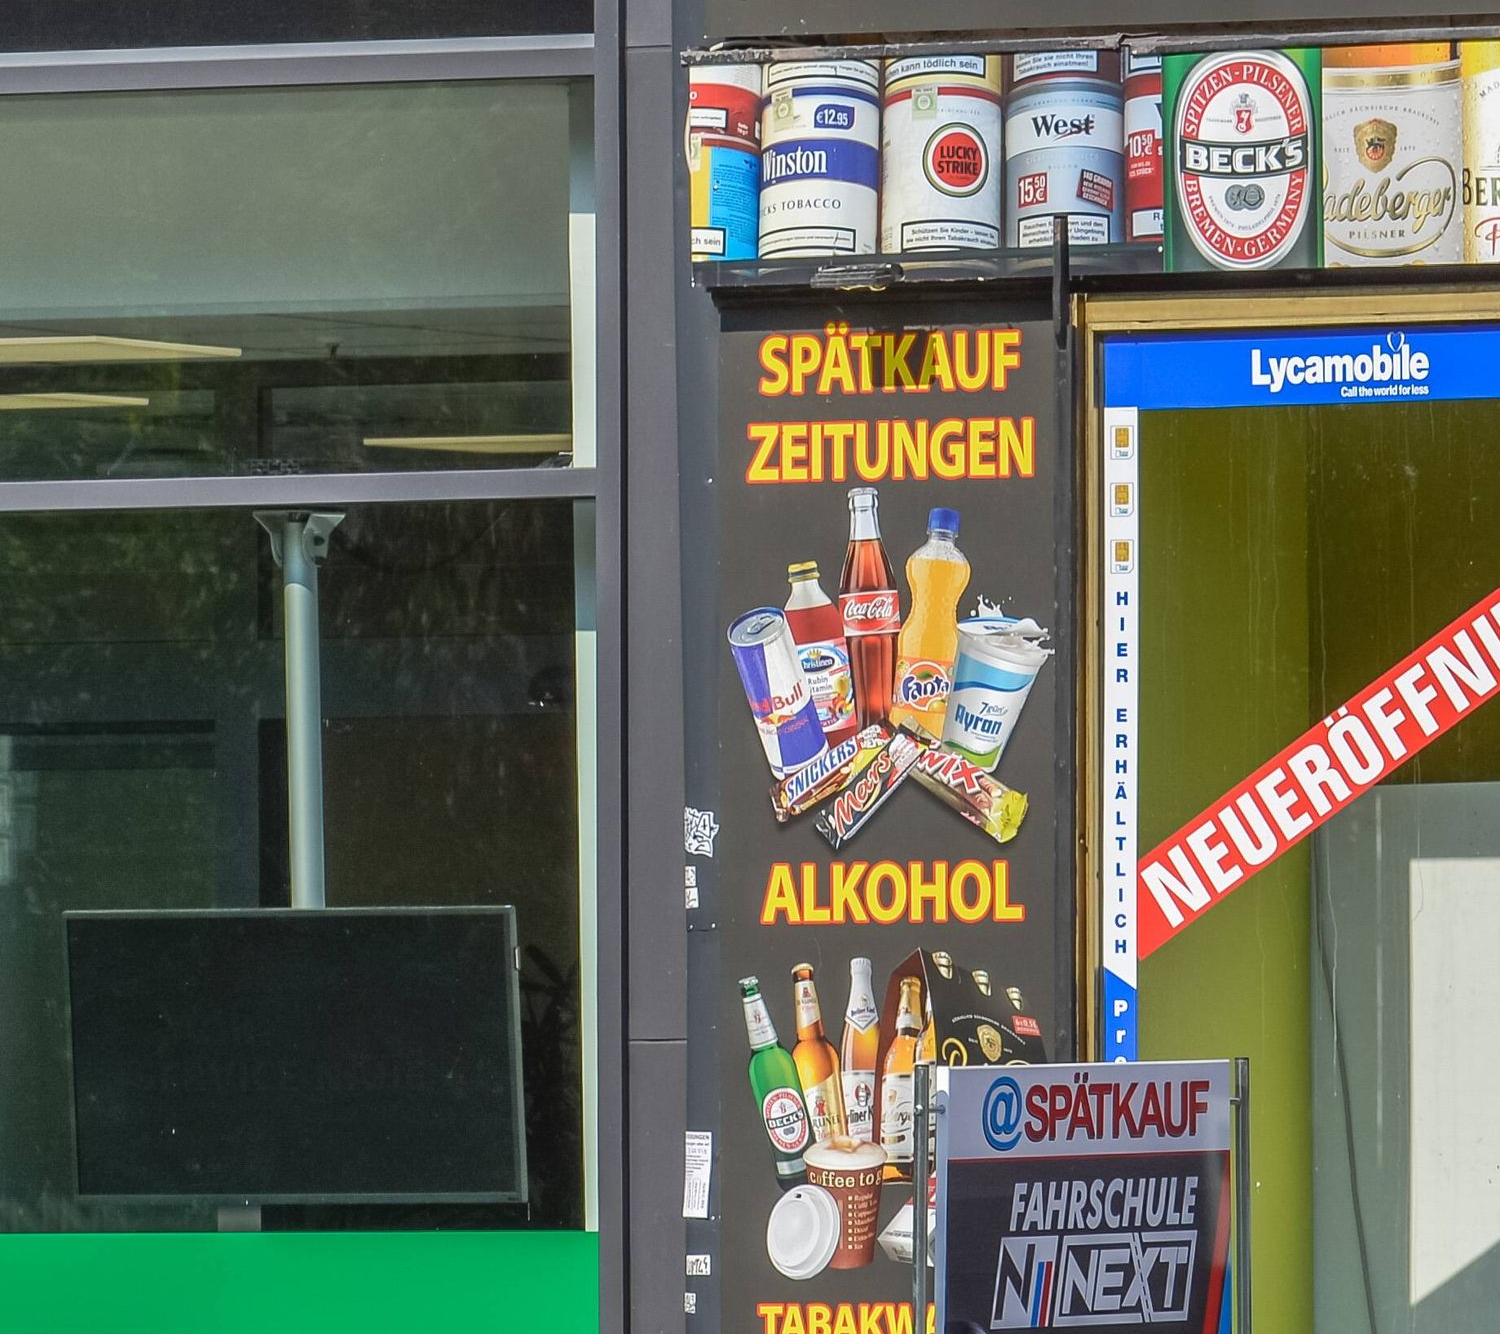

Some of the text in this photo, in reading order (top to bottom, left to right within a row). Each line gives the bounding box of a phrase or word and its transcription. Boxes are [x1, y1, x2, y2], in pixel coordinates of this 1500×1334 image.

[900, 59, 979, 72] kann tödlich sein
[816, 108, 849, 126] €12.95
[1032, 113, 1095, 139] West
[763, 146, 827, 184] Winston
[937, 160, 980, 176] STRIKE
[940, 145, 979, 159] LUCKY
[1185, 138, 1303, 174] BECK'S
[782, 199, 841, 212] TOBACCO
[1323, 176, 1452, 234] adeberger
[1348, 229, 1406, 240] PILSNER
[759, 321, 1022, 396] SPÄTKAUF
[1251, 332, 1430, 393] Lycamobile
[747, 417, 1035, 483] ZEITUNGEN
[843, 595, 895, 622] Coca-Cola
[773, 682, 803, 711] Bull
[902, 675, 950, 703] Fanta
[954, 704, 1003, 736] Ayran
[786, 737, 857, 802] SNICKERS
[919, 748, 983, 795] WIX
[1113, 591, 1129, 955] HIER ERHÄLTLICH
[834, 749, 892, 835] Mars
[760, 859, 1026, 926] ALKOHOL
[810, 1170, 874, 1188] coffee to
[1009, 1176, 1200, 1232] FAHRSCHULE
